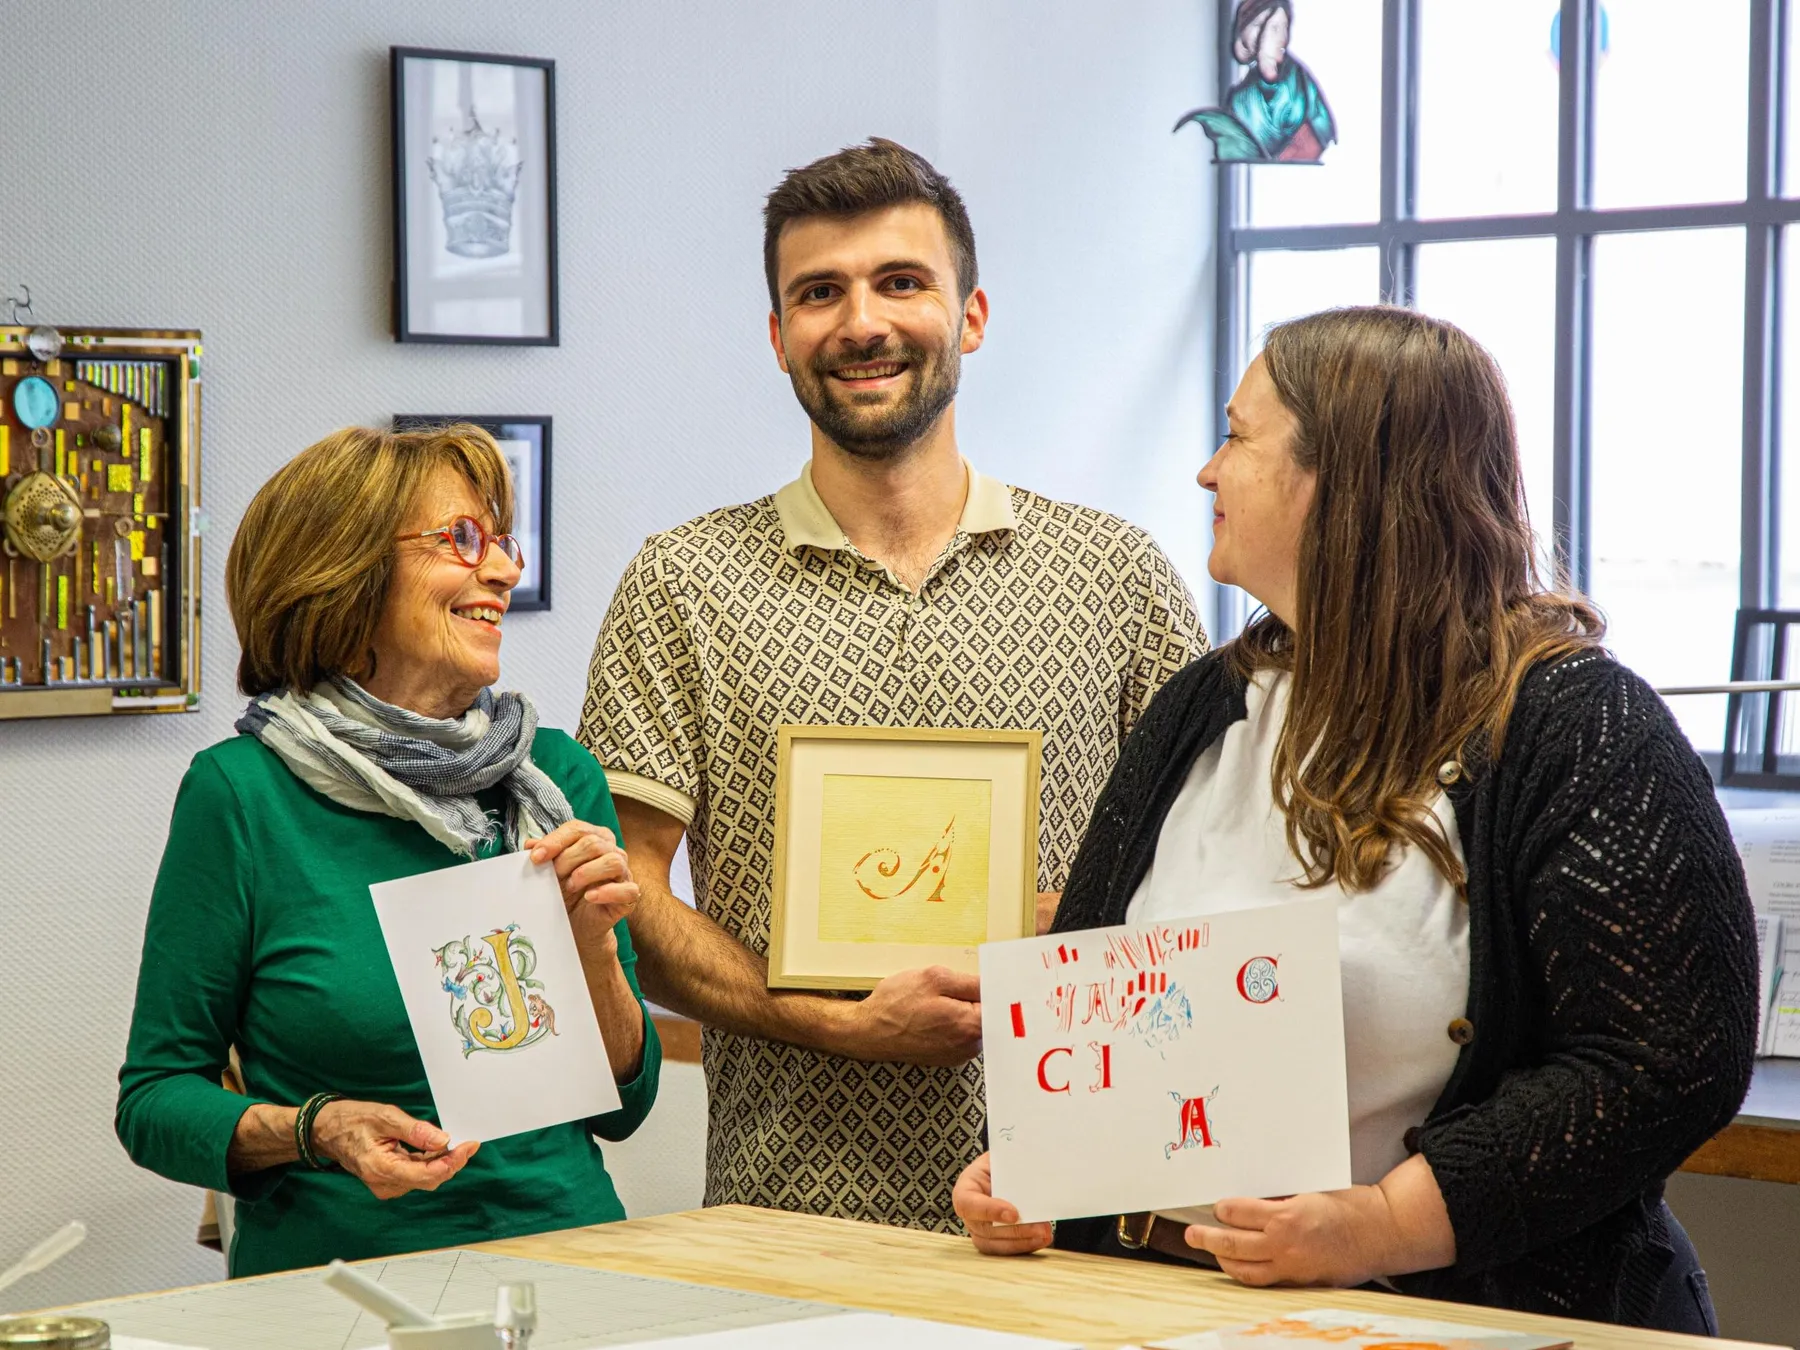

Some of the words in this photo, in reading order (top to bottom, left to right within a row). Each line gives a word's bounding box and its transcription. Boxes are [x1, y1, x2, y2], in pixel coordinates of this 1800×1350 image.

[852, 814, 956, 902] A
[469, 930, 531, 1049] J
[1037, 1046, 1074, 1095] C
[1169, 1094, 1217, 1152] A
